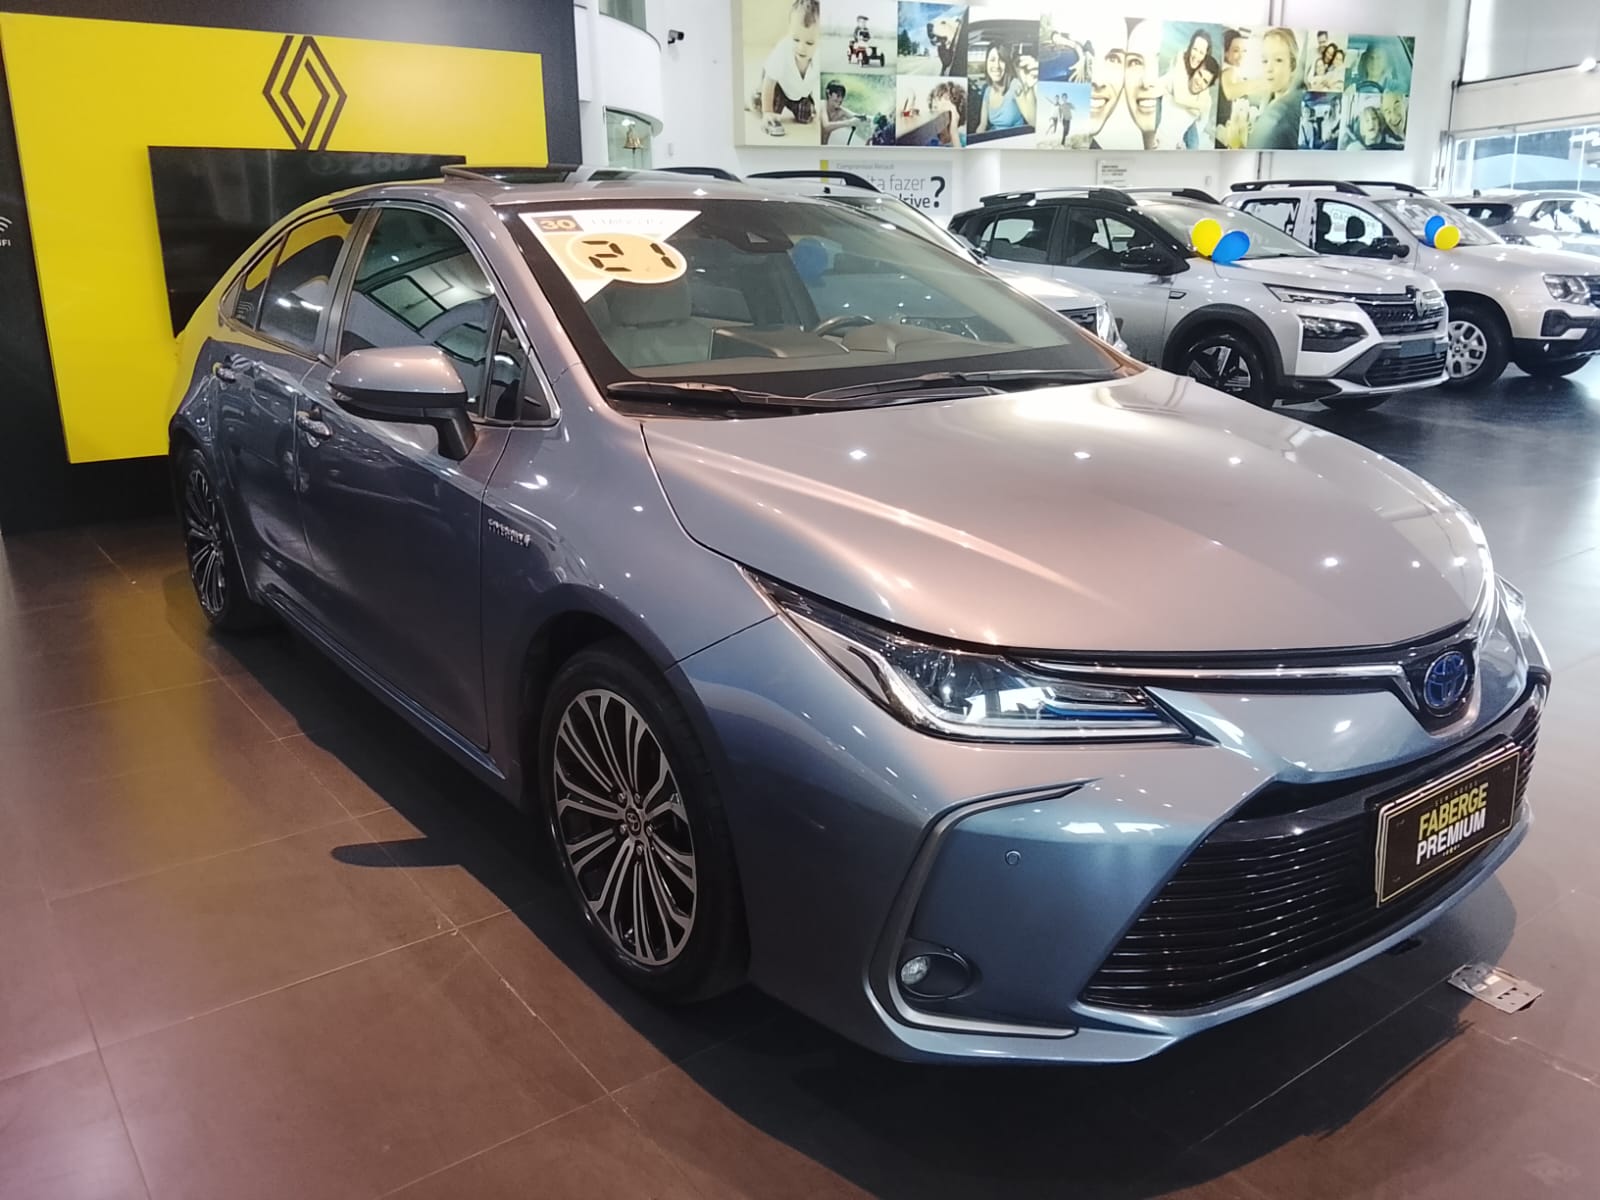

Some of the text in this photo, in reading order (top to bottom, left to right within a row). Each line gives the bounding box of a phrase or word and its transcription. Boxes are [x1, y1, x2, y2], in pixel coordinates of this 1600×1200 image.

[889, 174, 926, 191] fazer
[899, 193, 931, 209] rive
[539, 218, 577, 231] 30
[1418, 782, 1489, 842] FABERGE
[1416, 807, 1487, 866] PREMIUM
